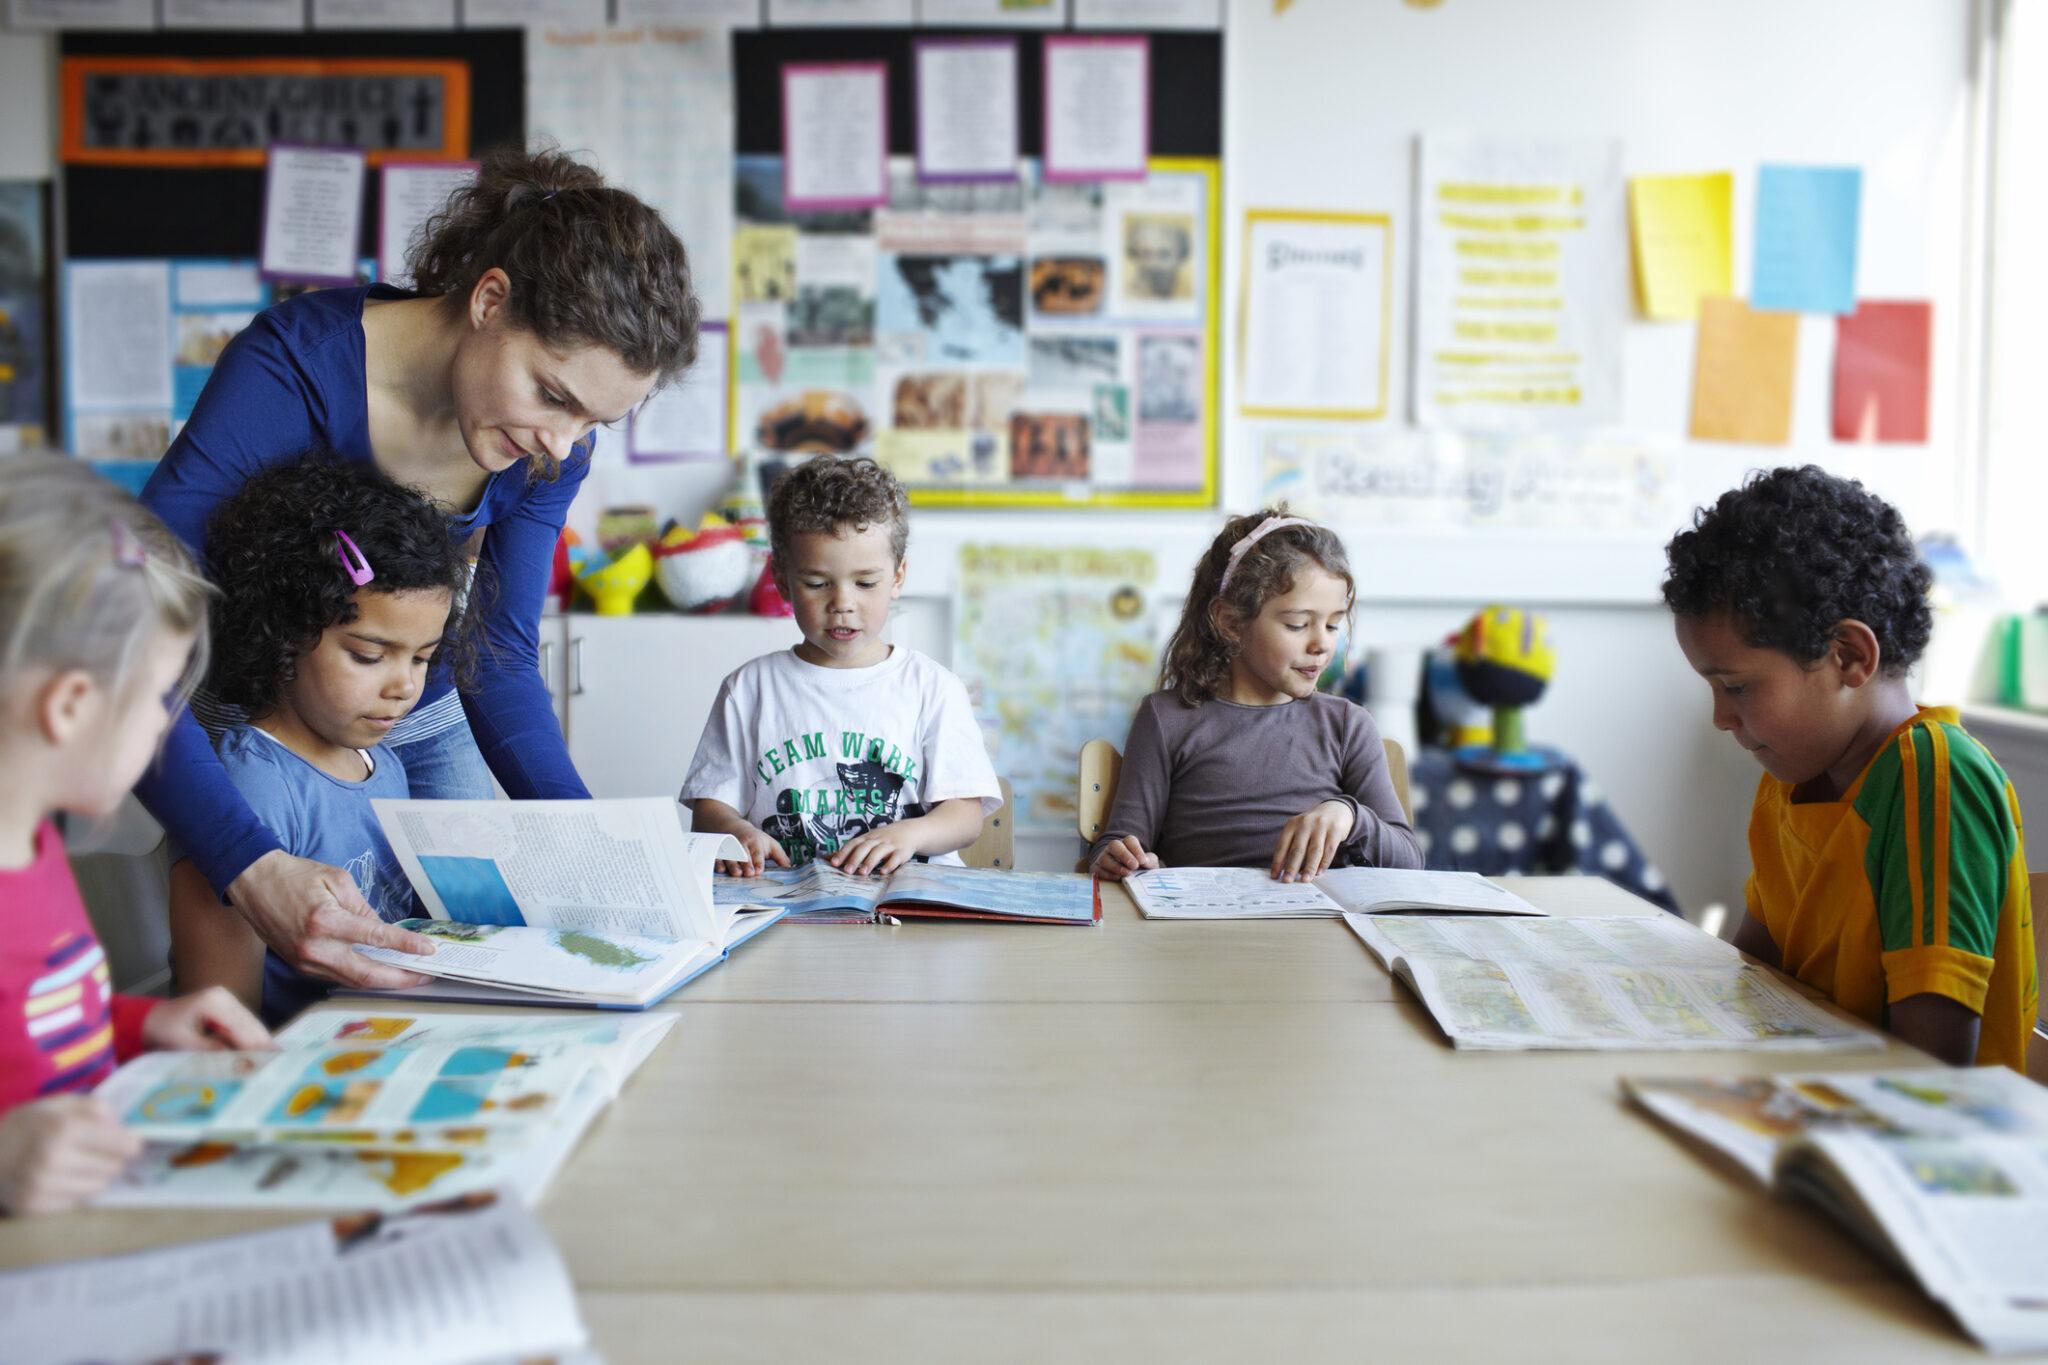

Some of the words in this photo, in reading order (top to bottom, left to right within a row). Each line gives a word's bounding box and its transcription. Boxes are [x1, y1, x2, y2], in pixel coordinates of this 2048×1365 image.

[757, 732, 827, 786] TEAM
[842, 731, 917, 783] WORK
[790, 788, 884, 815] MAKES
